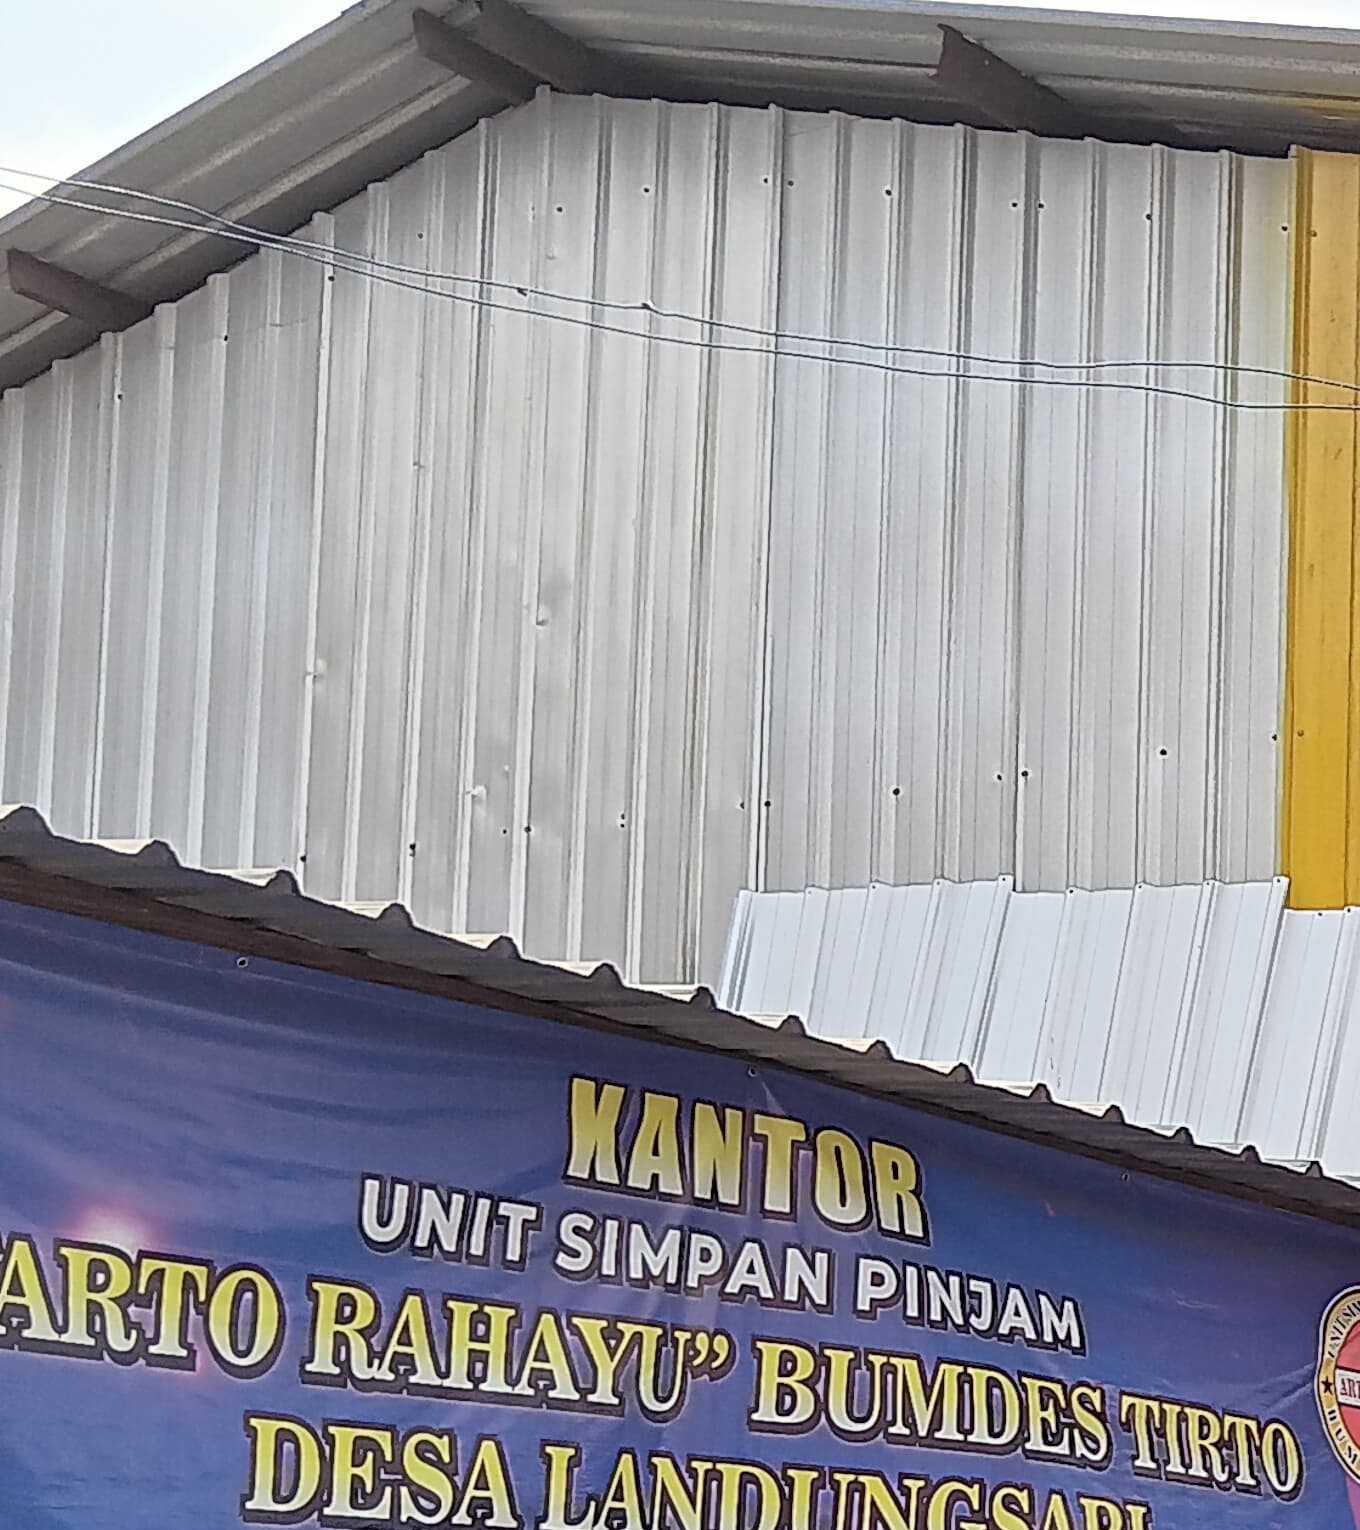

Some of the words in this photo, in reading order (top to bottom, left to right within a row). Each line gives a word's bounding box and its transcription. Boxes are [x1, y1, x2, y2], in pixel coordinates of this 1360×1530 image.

[565, 1077, 925, 1238] KANTOR
[361, 1177, 539, 1263] UNIT
[554, 1211, 829, 1306] SIMPAN
[856, 1258, 1082, 1350] PINJAM
[244, 1417, 519, 1528] DESA
[750, 1340, 1110, 1462] BUMDES
[1121, 1394, 1303, 1494] TIRTO
